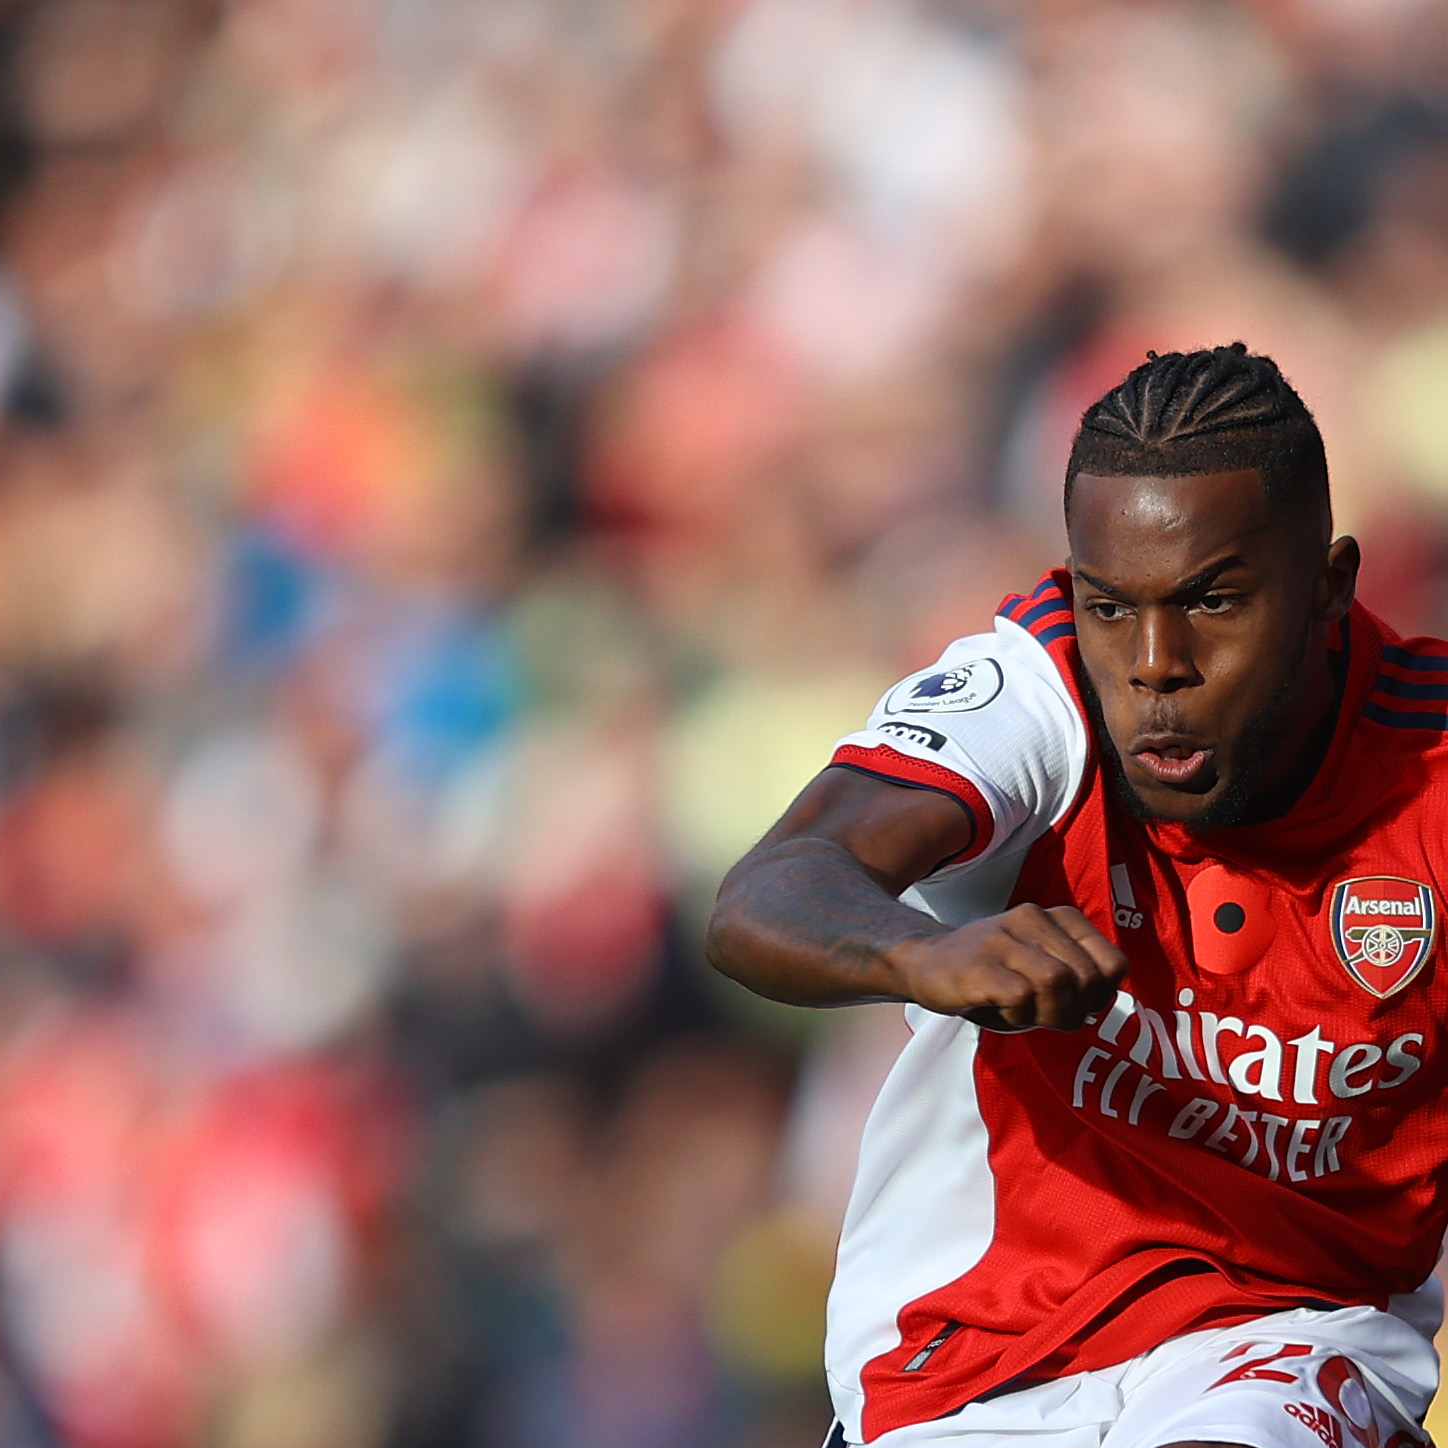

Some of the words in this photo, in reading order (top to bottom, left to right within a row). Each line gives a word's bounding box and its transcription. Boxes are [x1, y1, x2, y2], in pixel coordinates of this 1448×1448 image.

[1344, 895, 1422, 916] Arsenal
[1083, 987, 1424, 1105] mirates
[1072, 1046, 1168, 1126] FLY
[1168, 1097, 1353, 1183] BETTER
